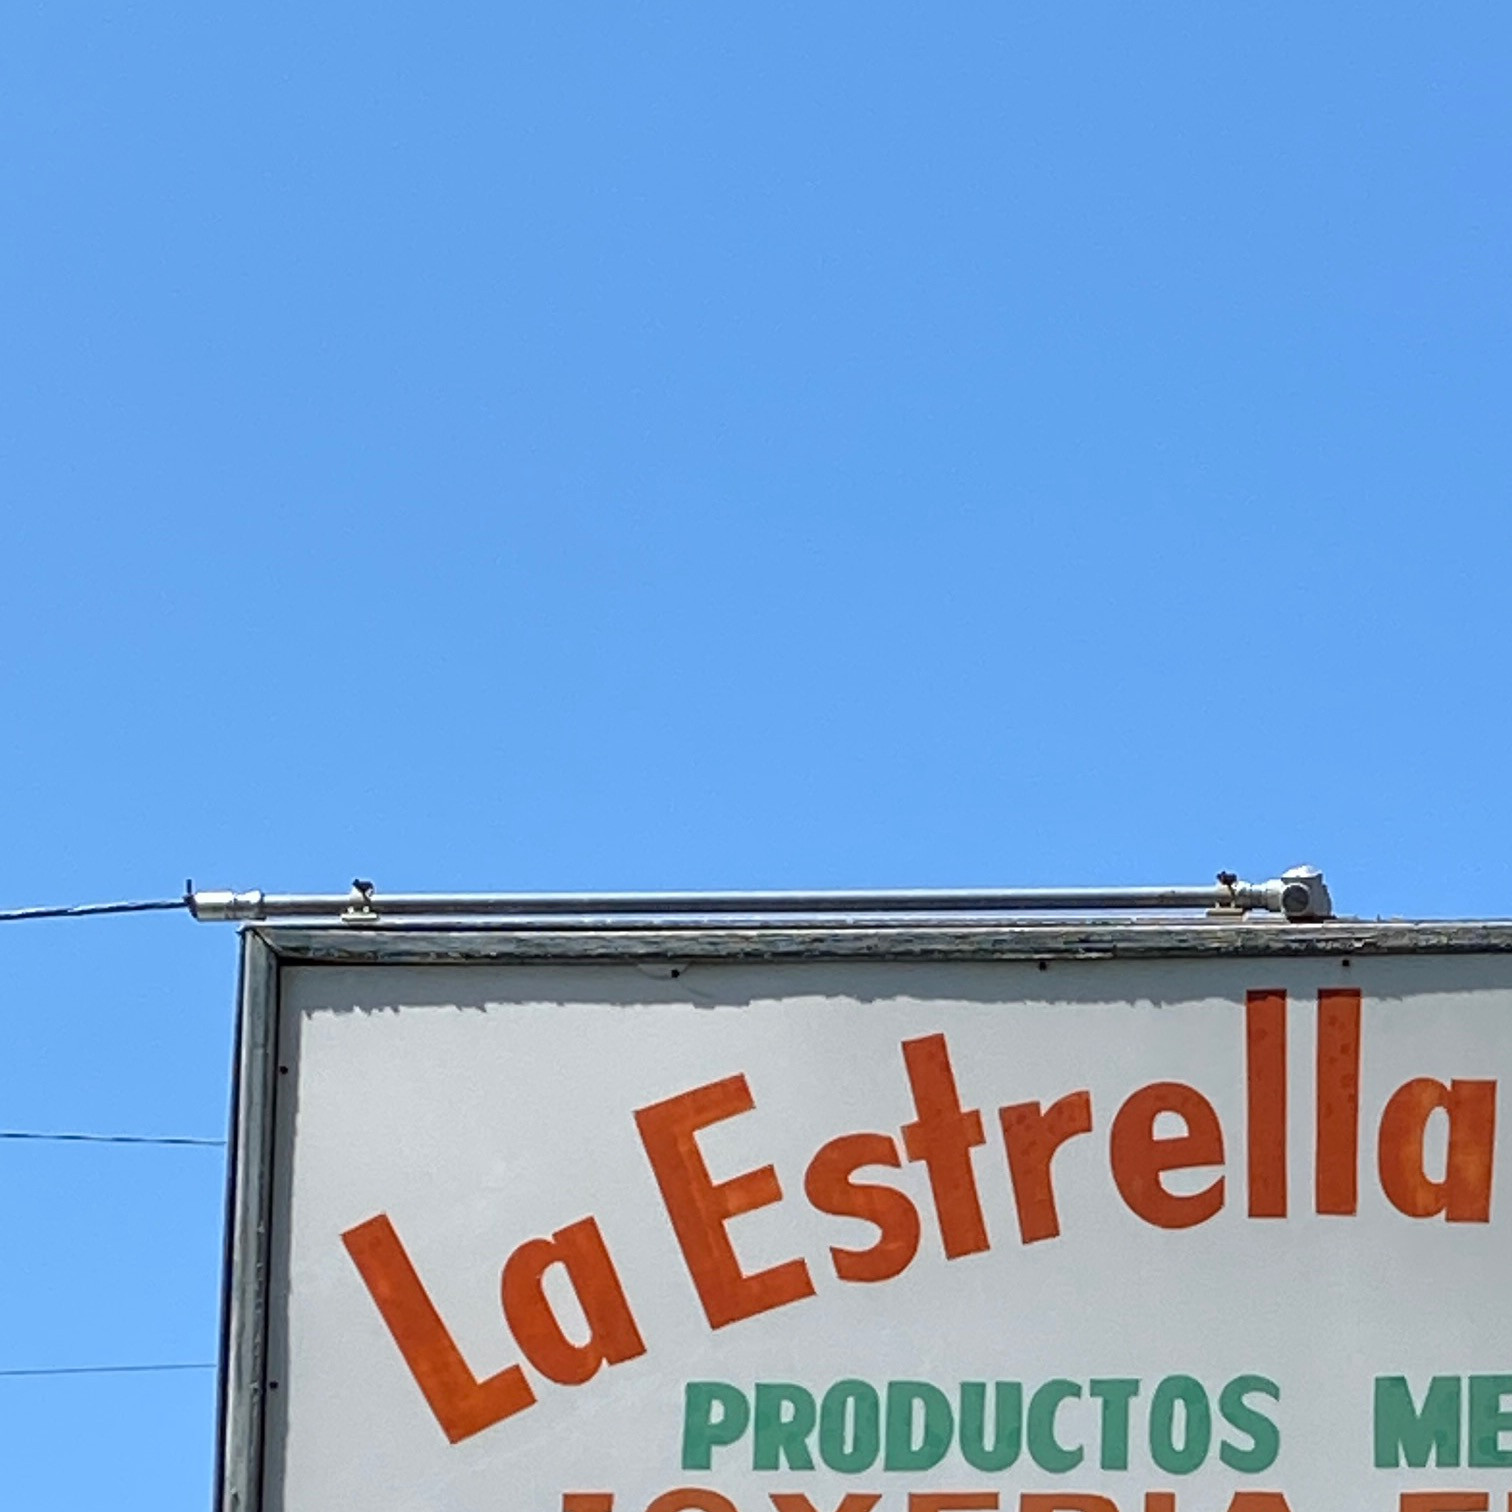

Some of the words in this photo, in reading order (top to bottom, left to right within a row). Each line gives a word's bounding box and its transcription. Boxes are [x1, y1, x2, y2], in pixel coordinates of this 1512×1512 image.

[341, 1213, 648, 1445] La
[634, 988, 1497, 1331] Estrella
[681, 1374, 1280, 1474] PRODUCTOS
